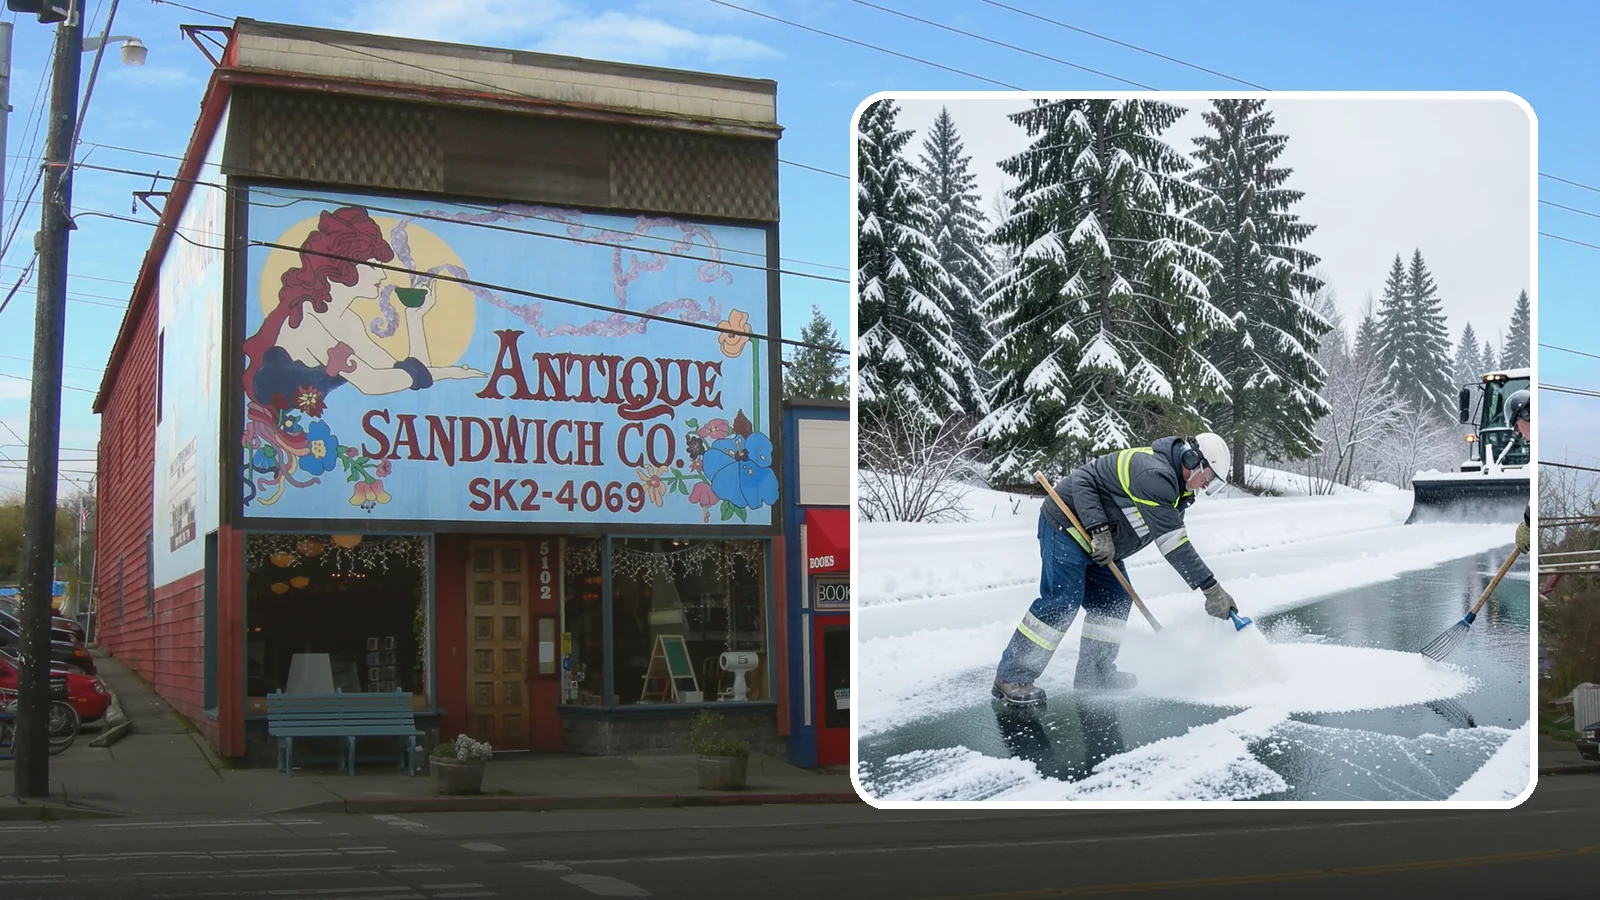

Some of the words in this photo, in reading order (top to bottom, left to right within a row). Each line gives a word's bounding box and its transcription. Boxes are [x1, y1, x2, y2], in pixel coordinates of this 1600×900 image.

[476, 329, 723, 421] ANTIQUE
[361, 408, 604, 467] SANDWICH
[617, 421, 685, 469] CO.
[468, 476, 646, 513] SK2-4069
[539, 542, 551, 599] 5102
[809, 555, 835, 569] BOOKS
